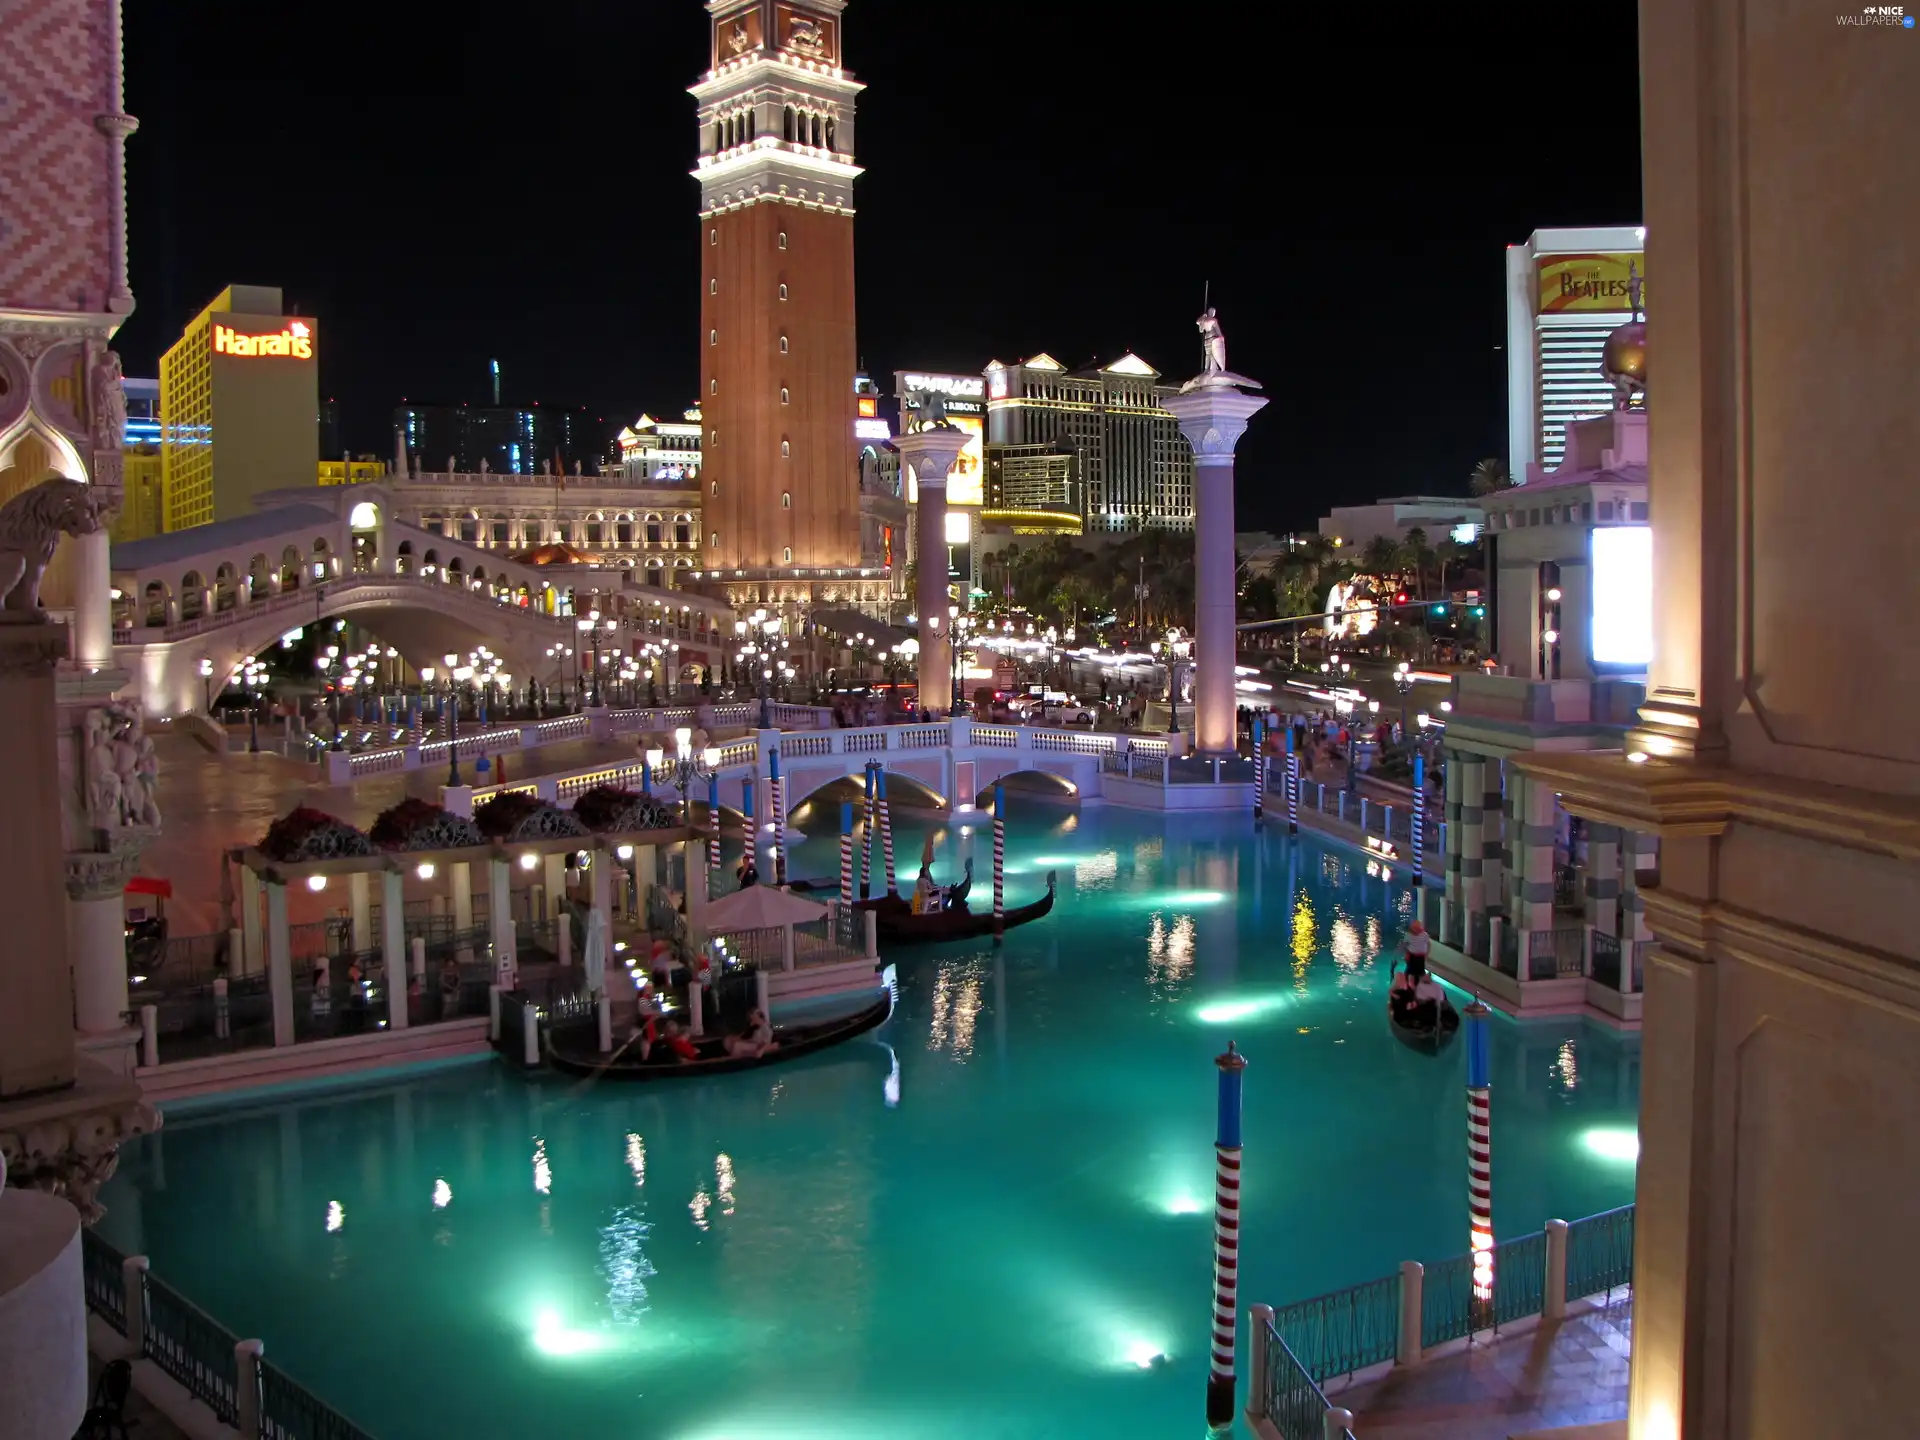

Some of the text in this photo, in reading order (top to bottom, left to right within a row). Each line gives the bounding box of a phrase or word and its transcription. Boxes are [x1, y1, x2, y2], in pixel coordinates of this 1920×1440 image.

[1587, 271, 1600, 280] THE
[1560, 272, 1628, 300] BEATLES
[949, 402, 981, 412] RESORT
